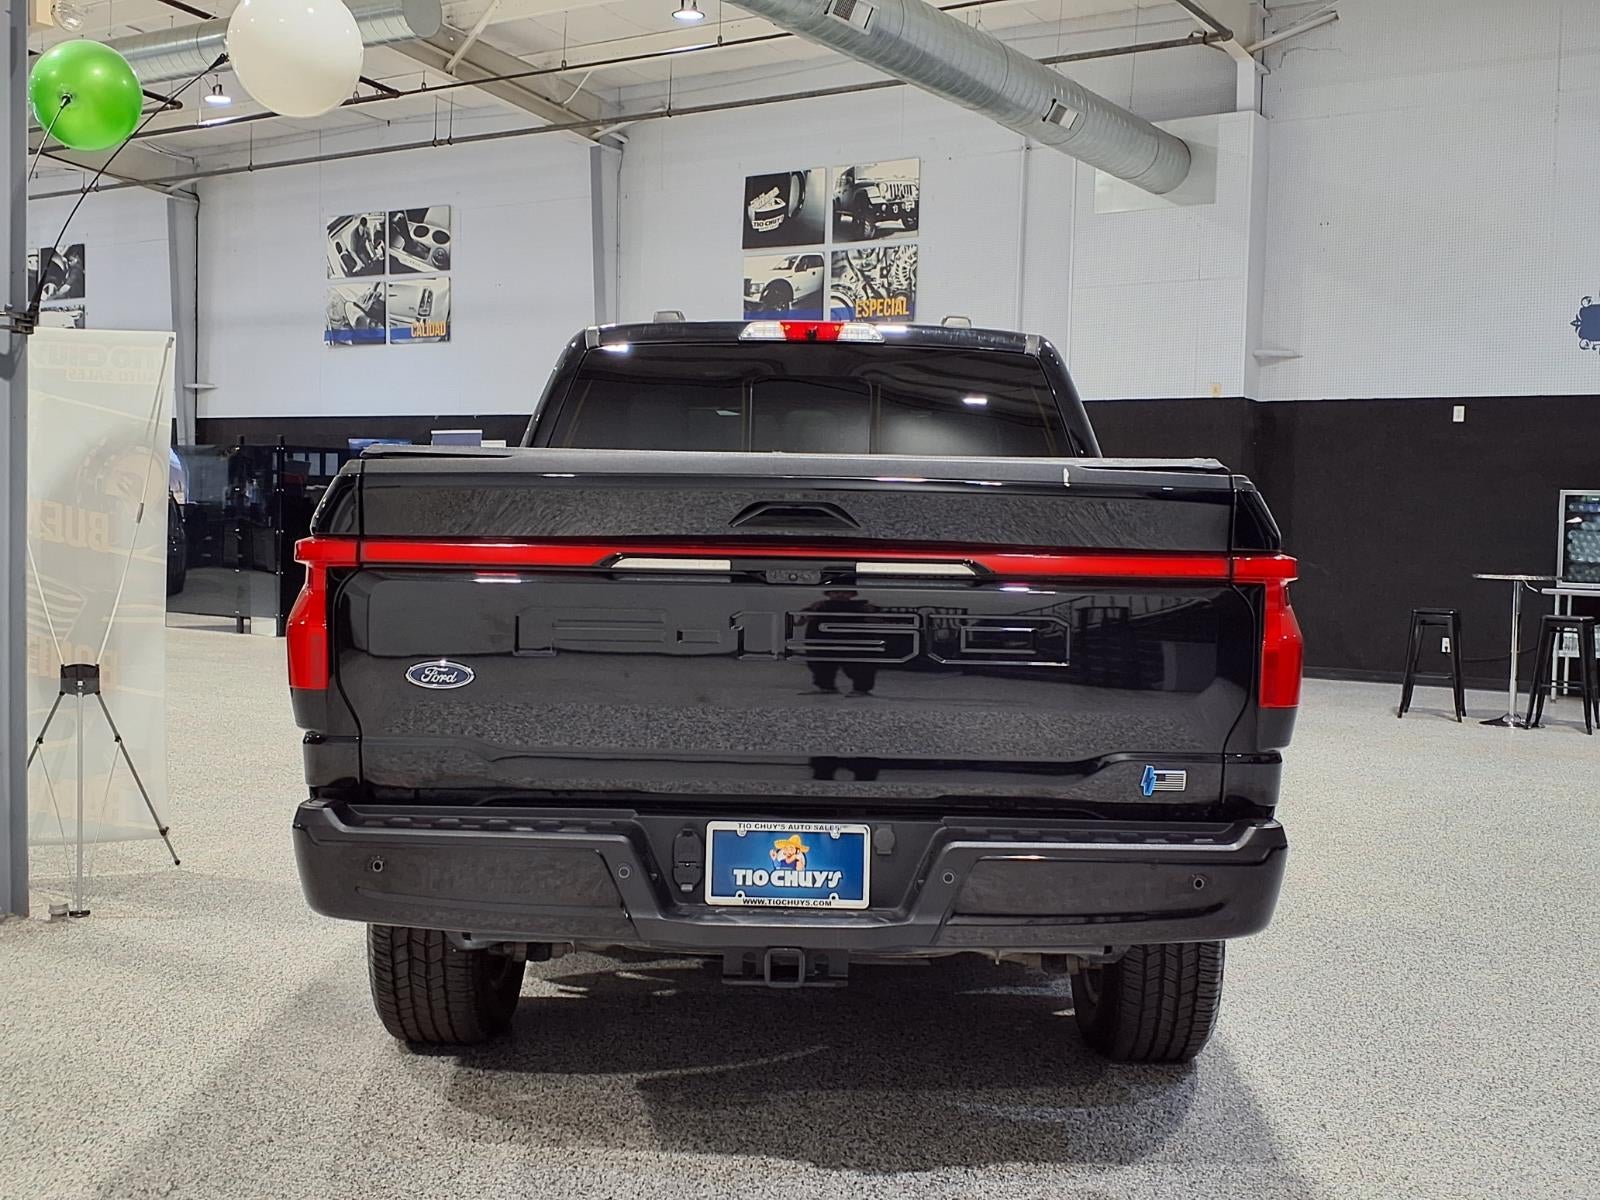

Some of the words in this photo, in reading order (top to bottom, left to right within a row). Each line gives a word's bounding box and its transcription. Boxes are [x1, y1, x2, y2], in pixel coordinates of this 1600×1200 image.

[855, 296, 910, 318] ESPECIAL
[410, 321, 446, 337] CALIDAD
[513, 606, 1071, 668] F-150
[420, 666, 458, 683] Ford
[738, 822, 752, 830] TIO
[733, 869, 769, 886] TIO
[770, 870, 842, 888] CHUY'S
[742, 898, 832, 907] WWW.TIOCHUYS.COM
